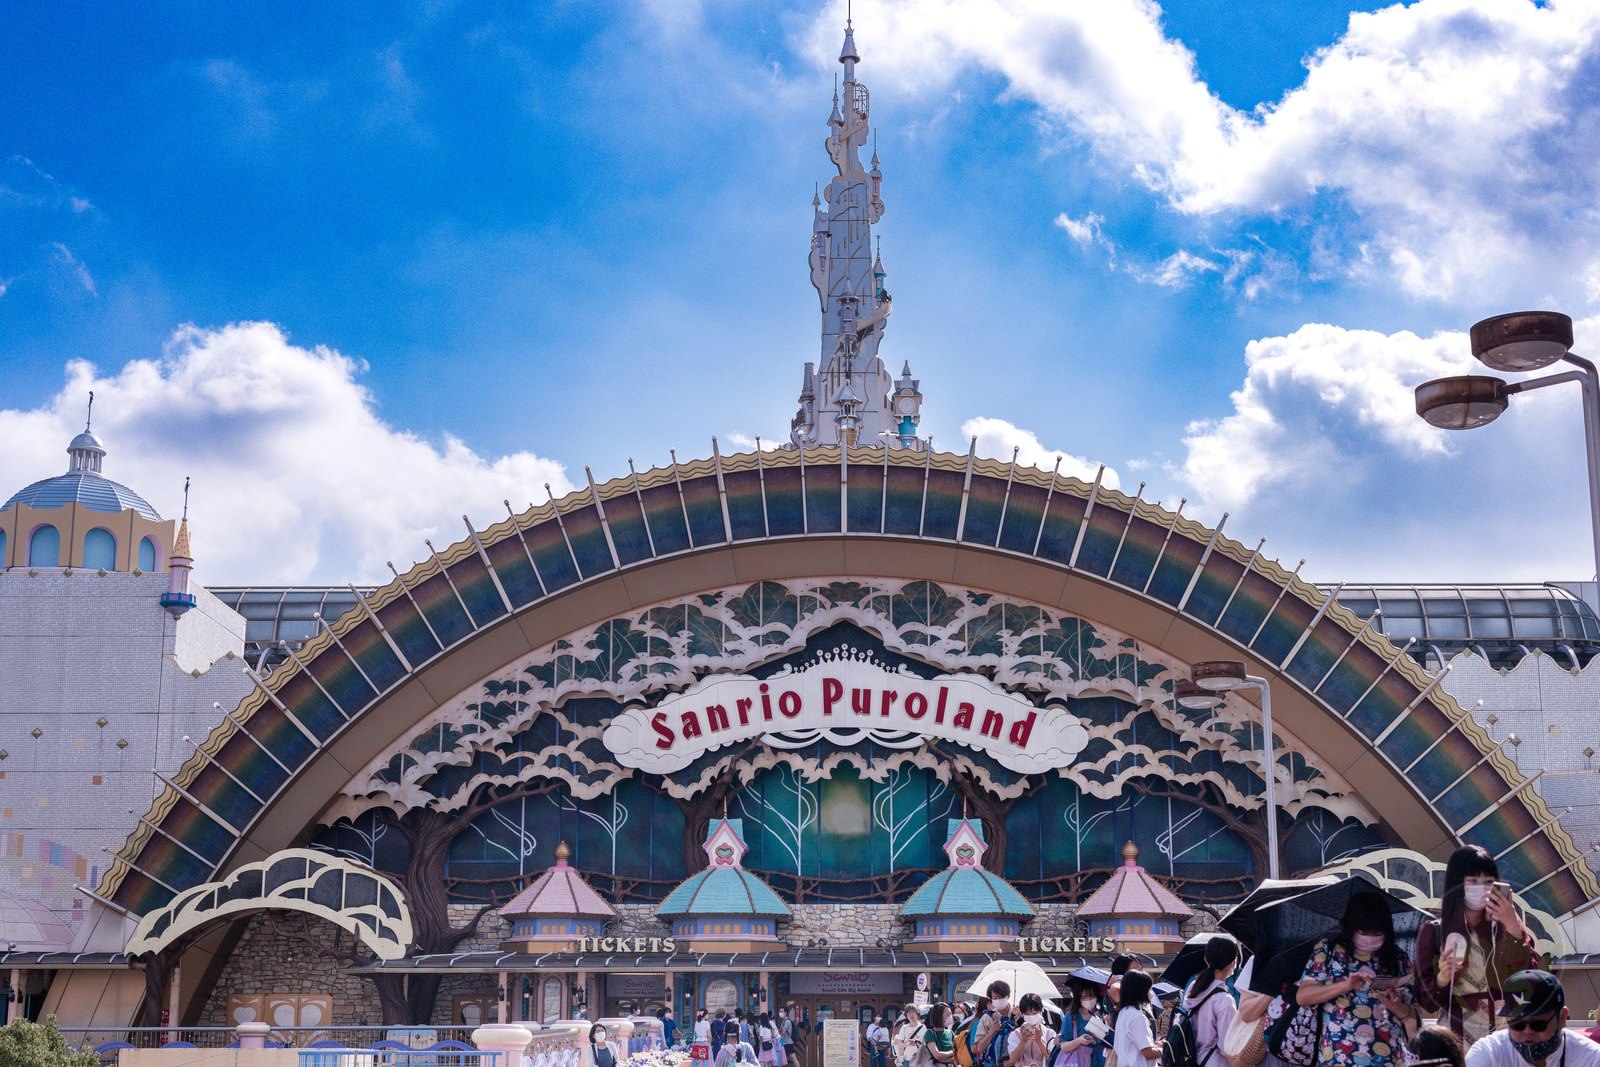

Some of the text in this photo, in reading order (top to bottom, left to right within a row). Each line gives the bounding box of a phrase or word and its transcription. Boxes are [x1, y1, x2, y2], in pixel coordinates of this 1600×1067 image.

[651, 677, 1037, 750] Sanrio Puroland
[577, 936, 677, 953] TICKETS
[1015, 936, 1116, 953] TICKETS
